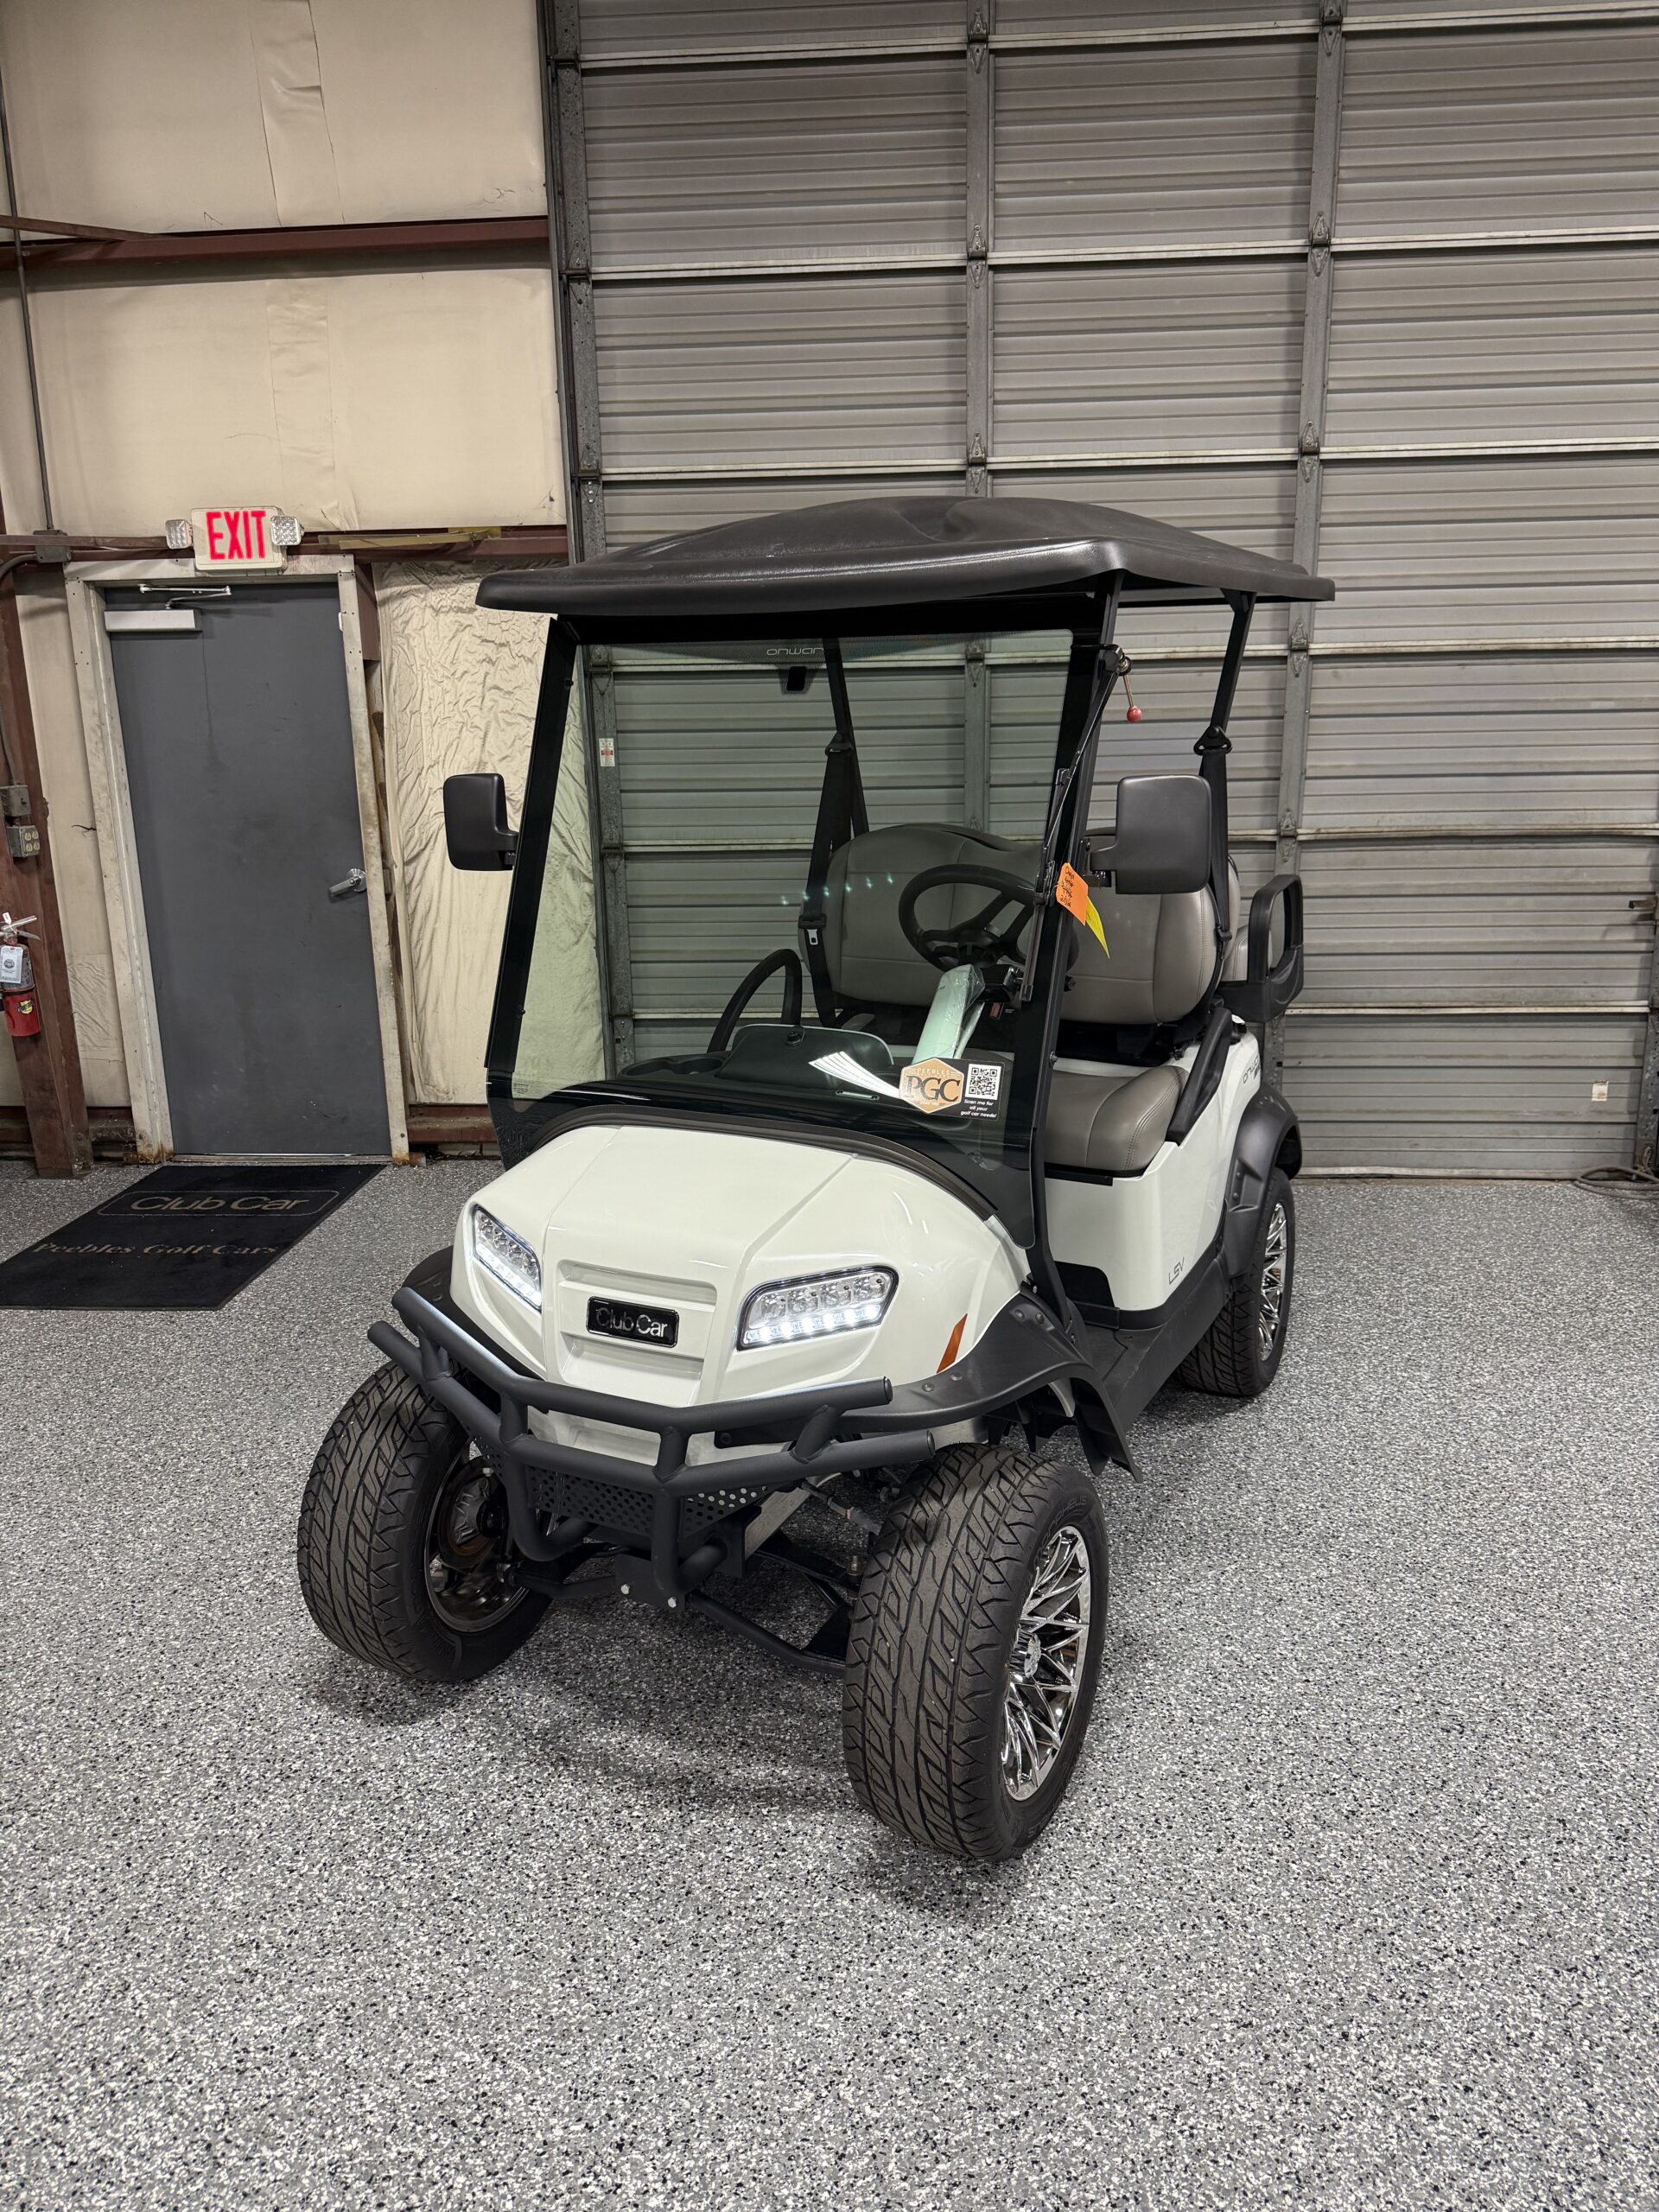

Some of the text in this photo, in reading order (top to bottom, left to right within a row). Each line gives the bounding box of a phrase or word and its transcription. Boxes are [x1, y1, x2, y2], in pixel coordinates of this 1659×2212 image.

[206, 510, 267, 560] EXIT
[906, 1075, 961, 1103] PGC
[130, 1196, 310, 1211] Club Car
[32, 1242, 278, 1255] Peebles Golf Cars
[1168, 1255, 1185, 1285] LSV
[595, 1306, 669, 1338] Club Car
